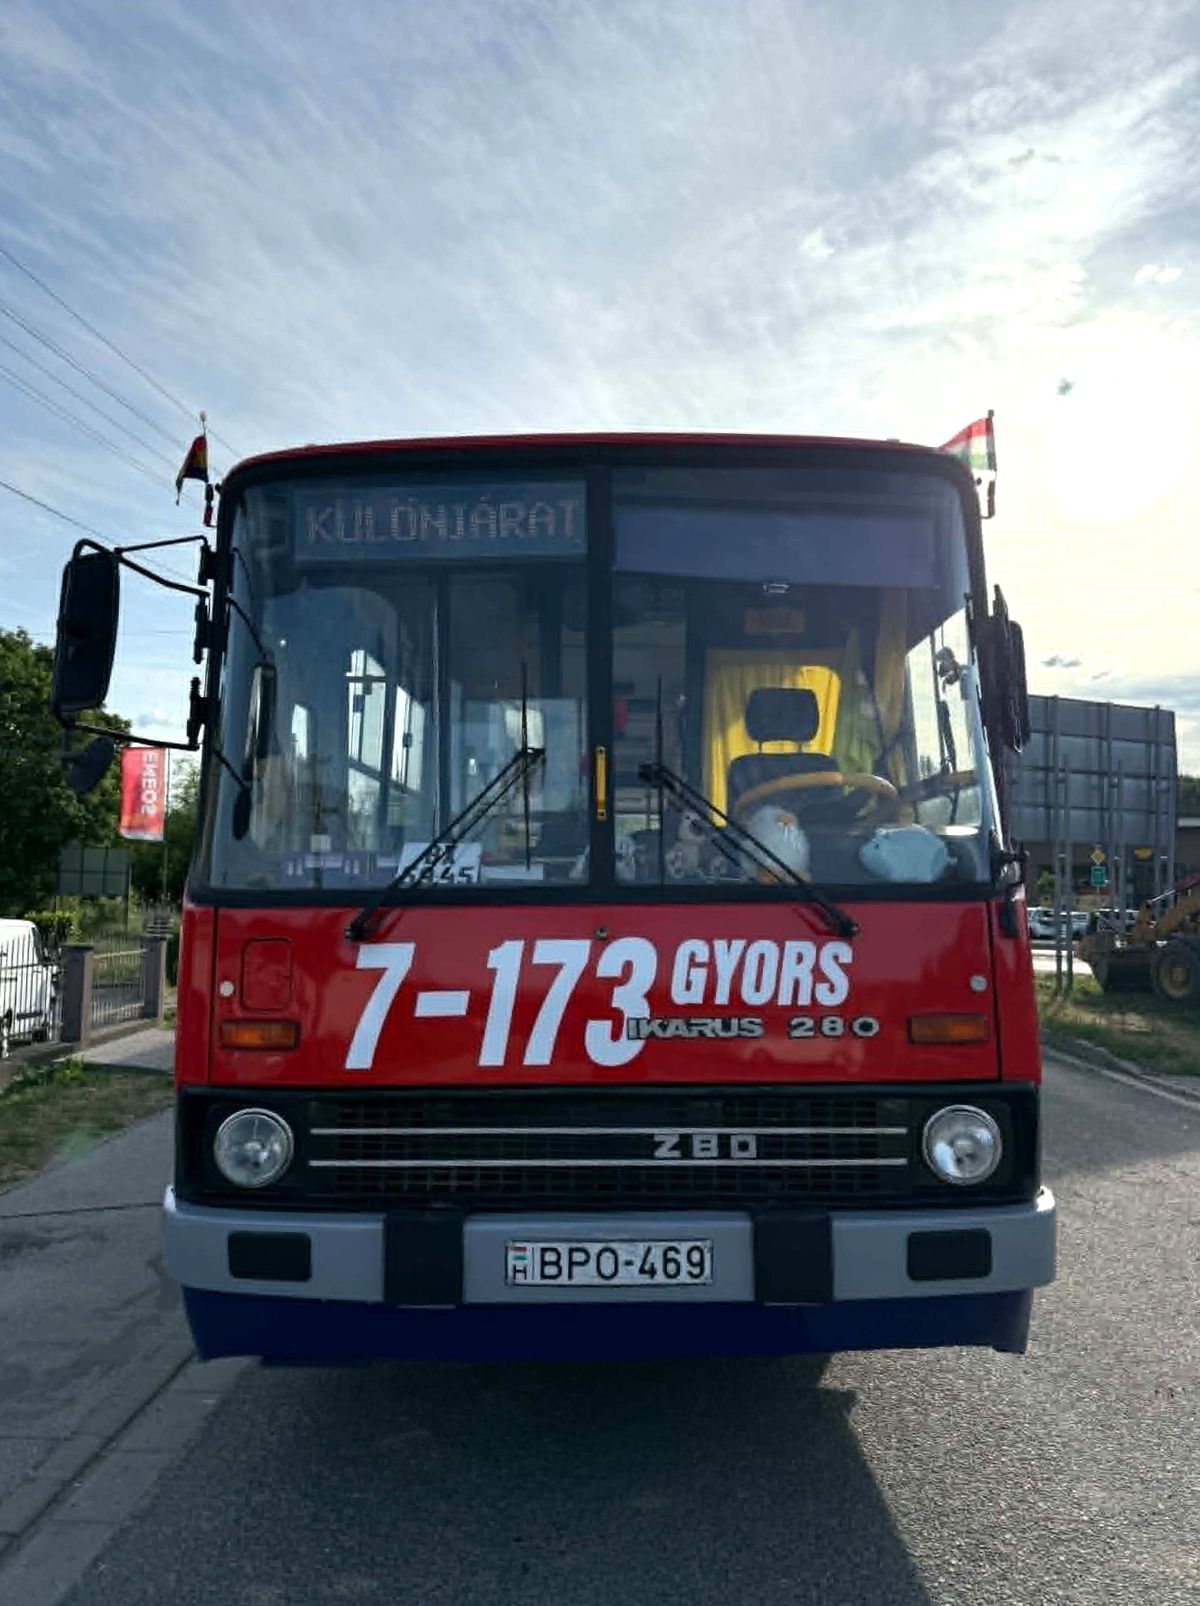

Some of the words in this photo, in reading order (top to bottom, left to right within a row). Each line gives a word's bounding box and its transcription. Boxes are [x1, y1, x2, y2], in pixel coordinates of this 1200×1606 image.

[345, 936, 658, 1070] 7-173
[671, 938, 854, 1007] GYORS
[626, 1016, 764, 1040] IKARUS
[788, 1015, 880, 1039] 280
[512, 1264, 528, 1281] H
[539, 1245, 706, 1281] BPO-469
